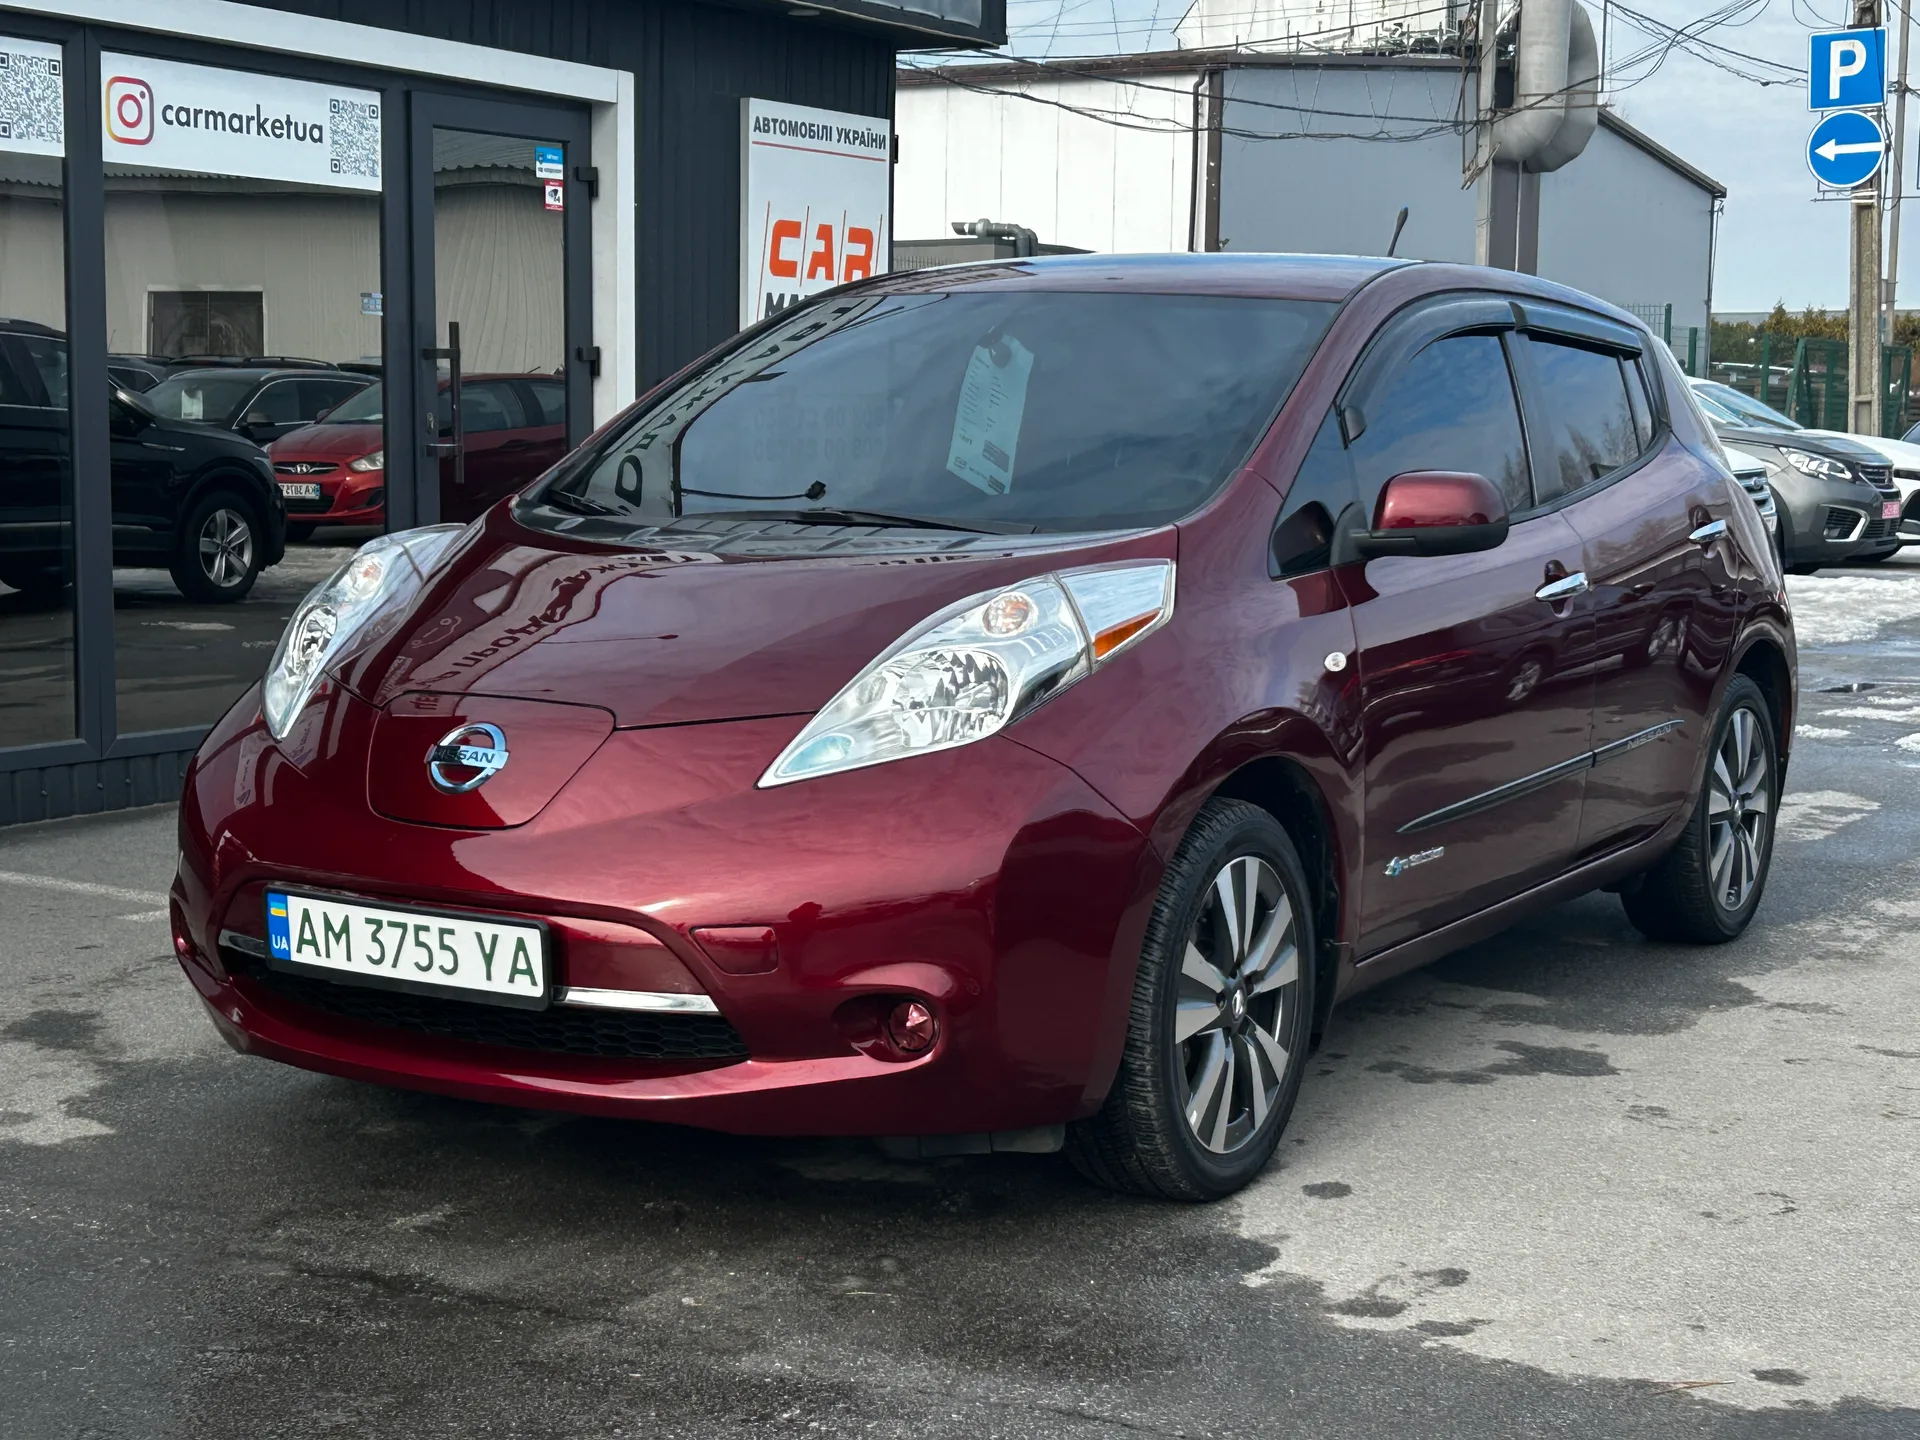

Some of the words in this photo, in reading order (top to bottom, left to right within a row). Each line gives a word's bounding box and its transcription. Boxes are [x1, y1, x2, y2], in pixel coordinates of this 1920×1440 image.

[1829, 39, 1867, 100] P
[161, 104, 324, 144] carmarketua
[753, 115, 833, 142] АВТОМОБІЛІ
[835, 127, 887, 150] УКРАЇНИ
[769, 219, 874, 282] CAR
[272, 934, 289, 951] UA
[296, 907, 352, 962] AM
[364, 917, 460, 976] 3755
[474, 931, 539, 987] YA
